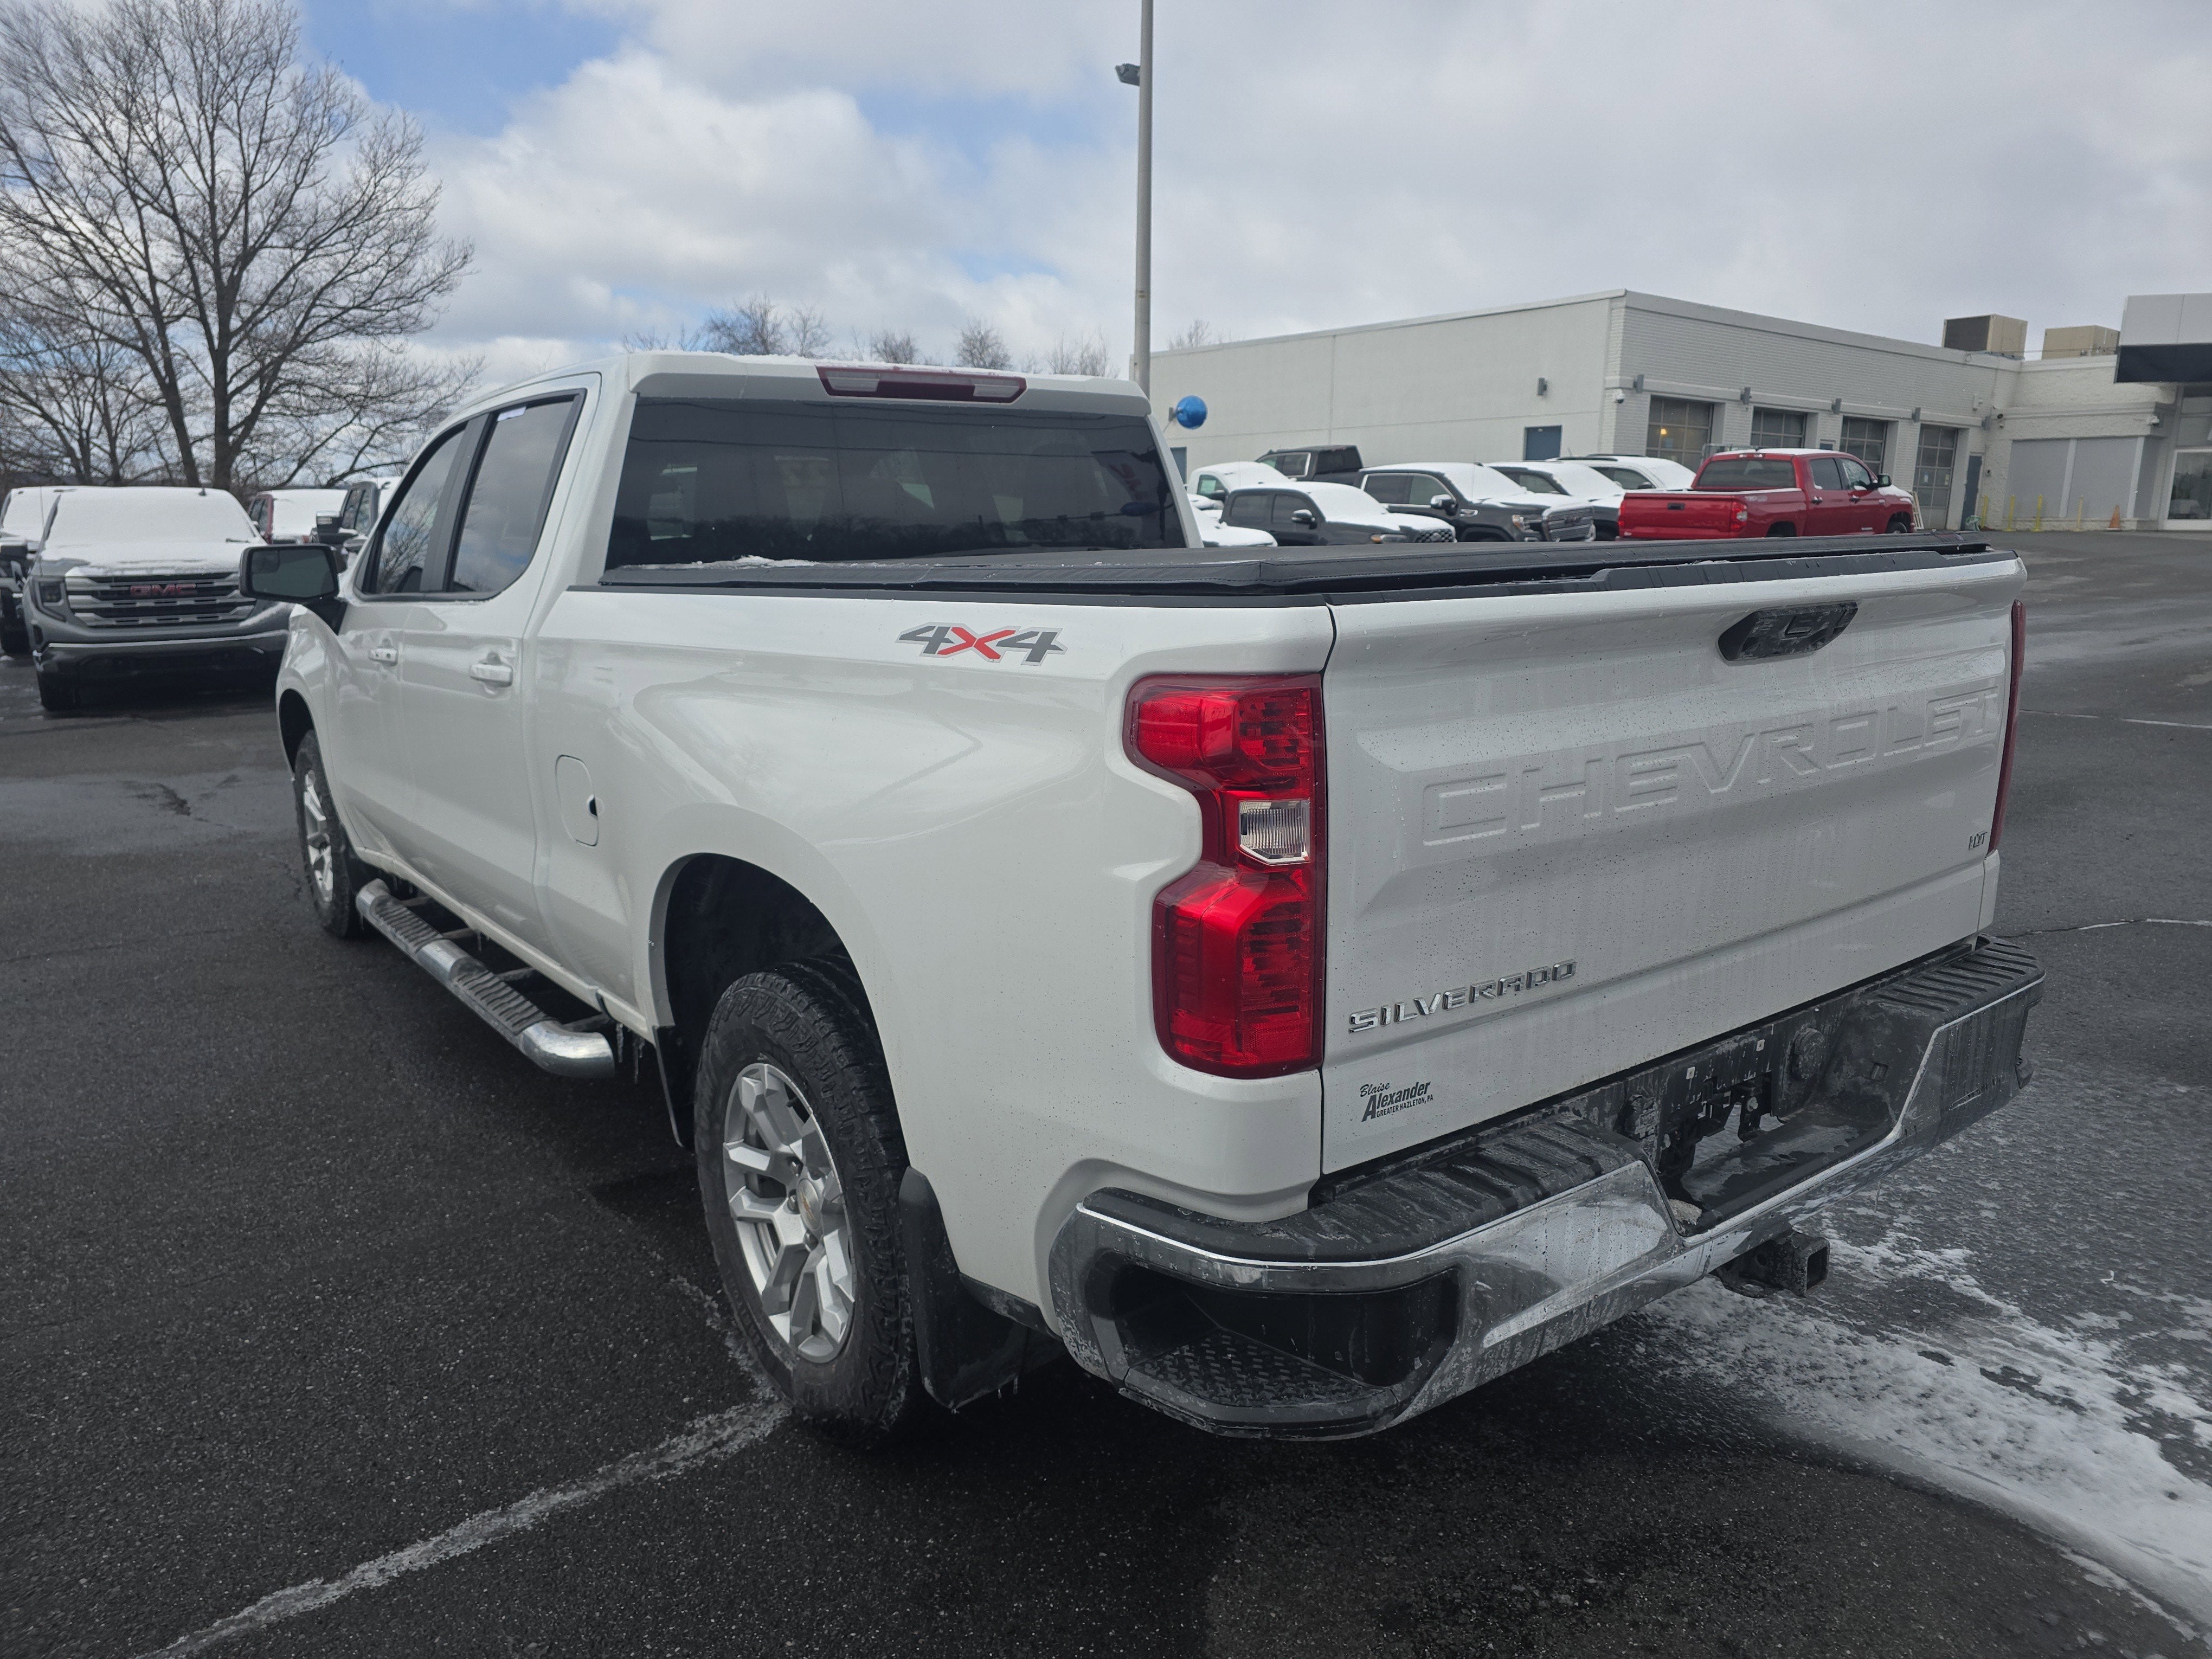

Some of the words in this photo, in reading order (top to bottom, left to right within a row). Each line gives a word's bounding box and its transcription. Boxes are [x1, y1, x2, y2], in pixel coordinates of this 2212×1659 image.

[130, 583, 196, 597] GMC
[1423, 686, 1999, 846] CHEVROLET
[1349, 959, 1577, 1033] SILVERADO
[1360, 1083, 1390, 1097] Blaise
[1361, 1082, 1431, 1122] Alexander
[1377, 1107, 1399, 1117] GREATER
[1400, 1097, 1426, 1110] HAZLETON,
[1427, 1094, 1434, 1102] PA
